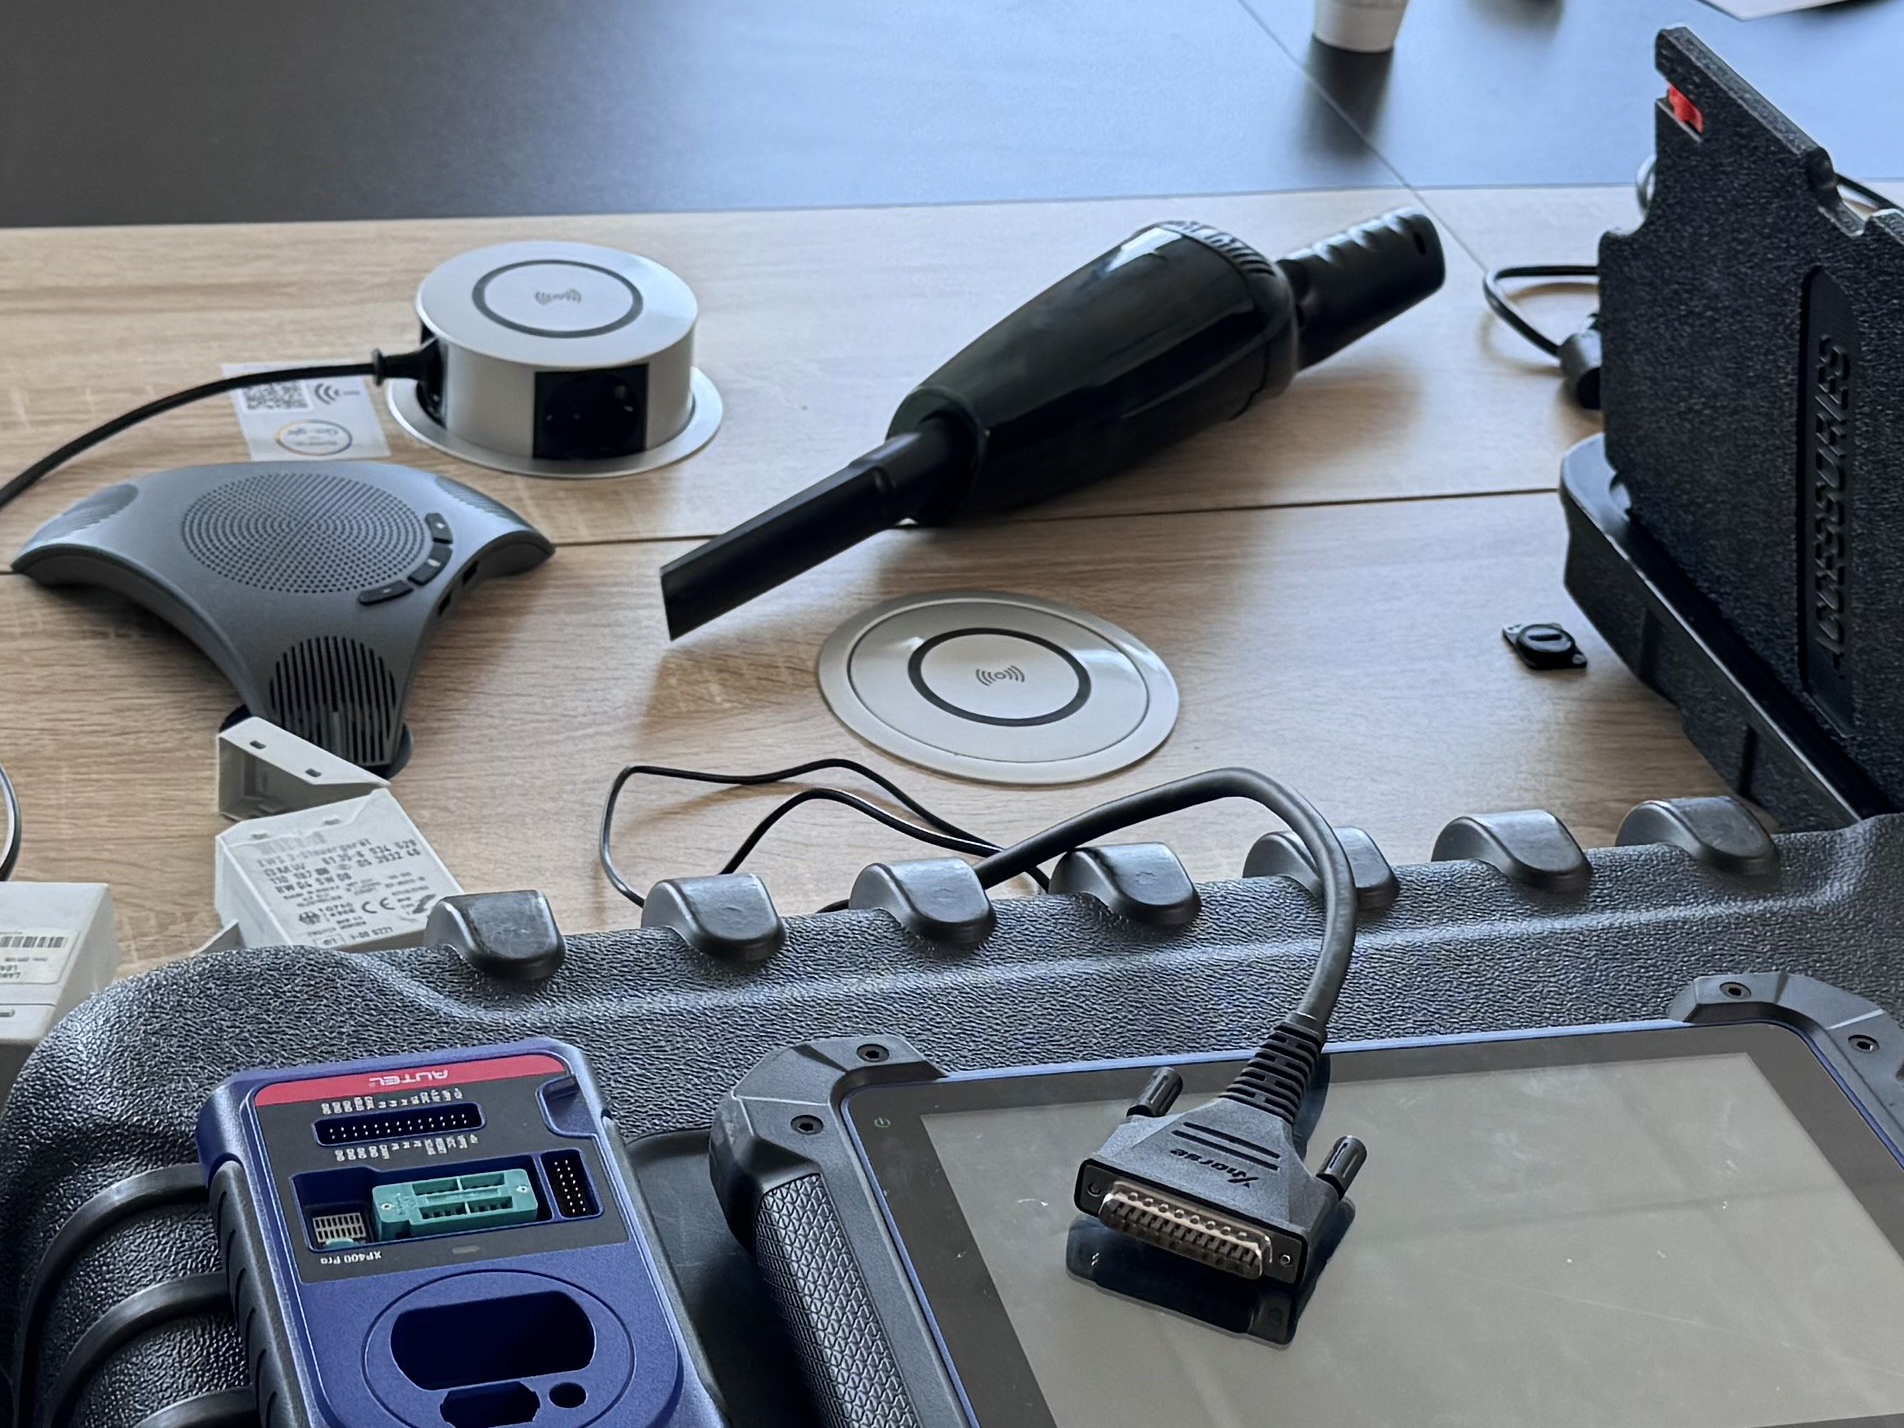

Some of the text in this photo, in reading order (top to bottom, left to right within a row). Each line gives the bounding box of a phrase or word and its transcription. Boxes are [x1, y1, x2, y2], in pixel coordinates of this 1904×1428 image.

[368, 1069, 449, 1086] AUTEL
[1170, 1148, 1260, 1189] Xhorse
[320, 1250, 382, 1265] XP400 Pro
